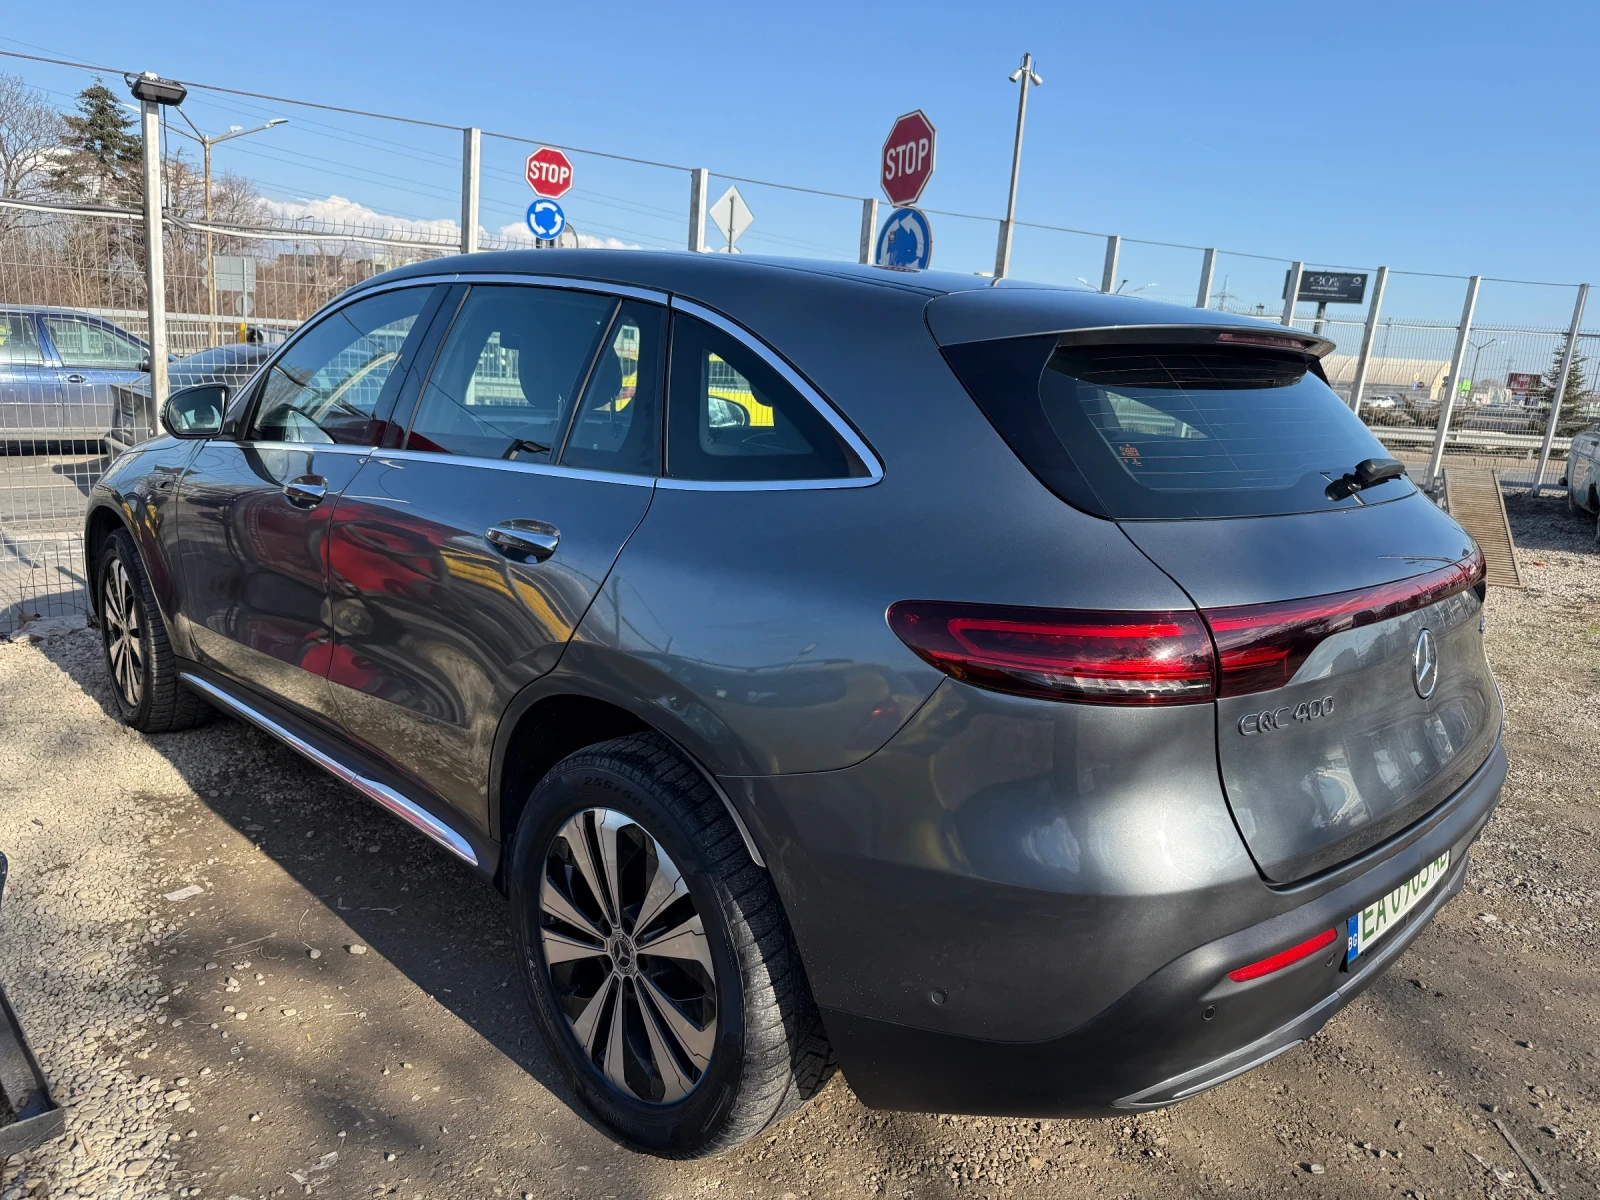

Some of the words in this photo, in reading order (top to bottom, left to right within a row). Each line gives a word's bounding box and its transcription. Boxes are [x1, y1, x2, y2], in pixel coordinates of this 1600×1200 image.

[529, 160, 570, 185] STOP
[885, 138, 929, 180] STOP
[1238, 706, 1289, 736] EQC
[1292, 695, 1335, 723] 400
[583, 776, 643, 807] 255/50
[1362, 896, 1387, 943] EA
[1348, 933, 1358, 952] BG
